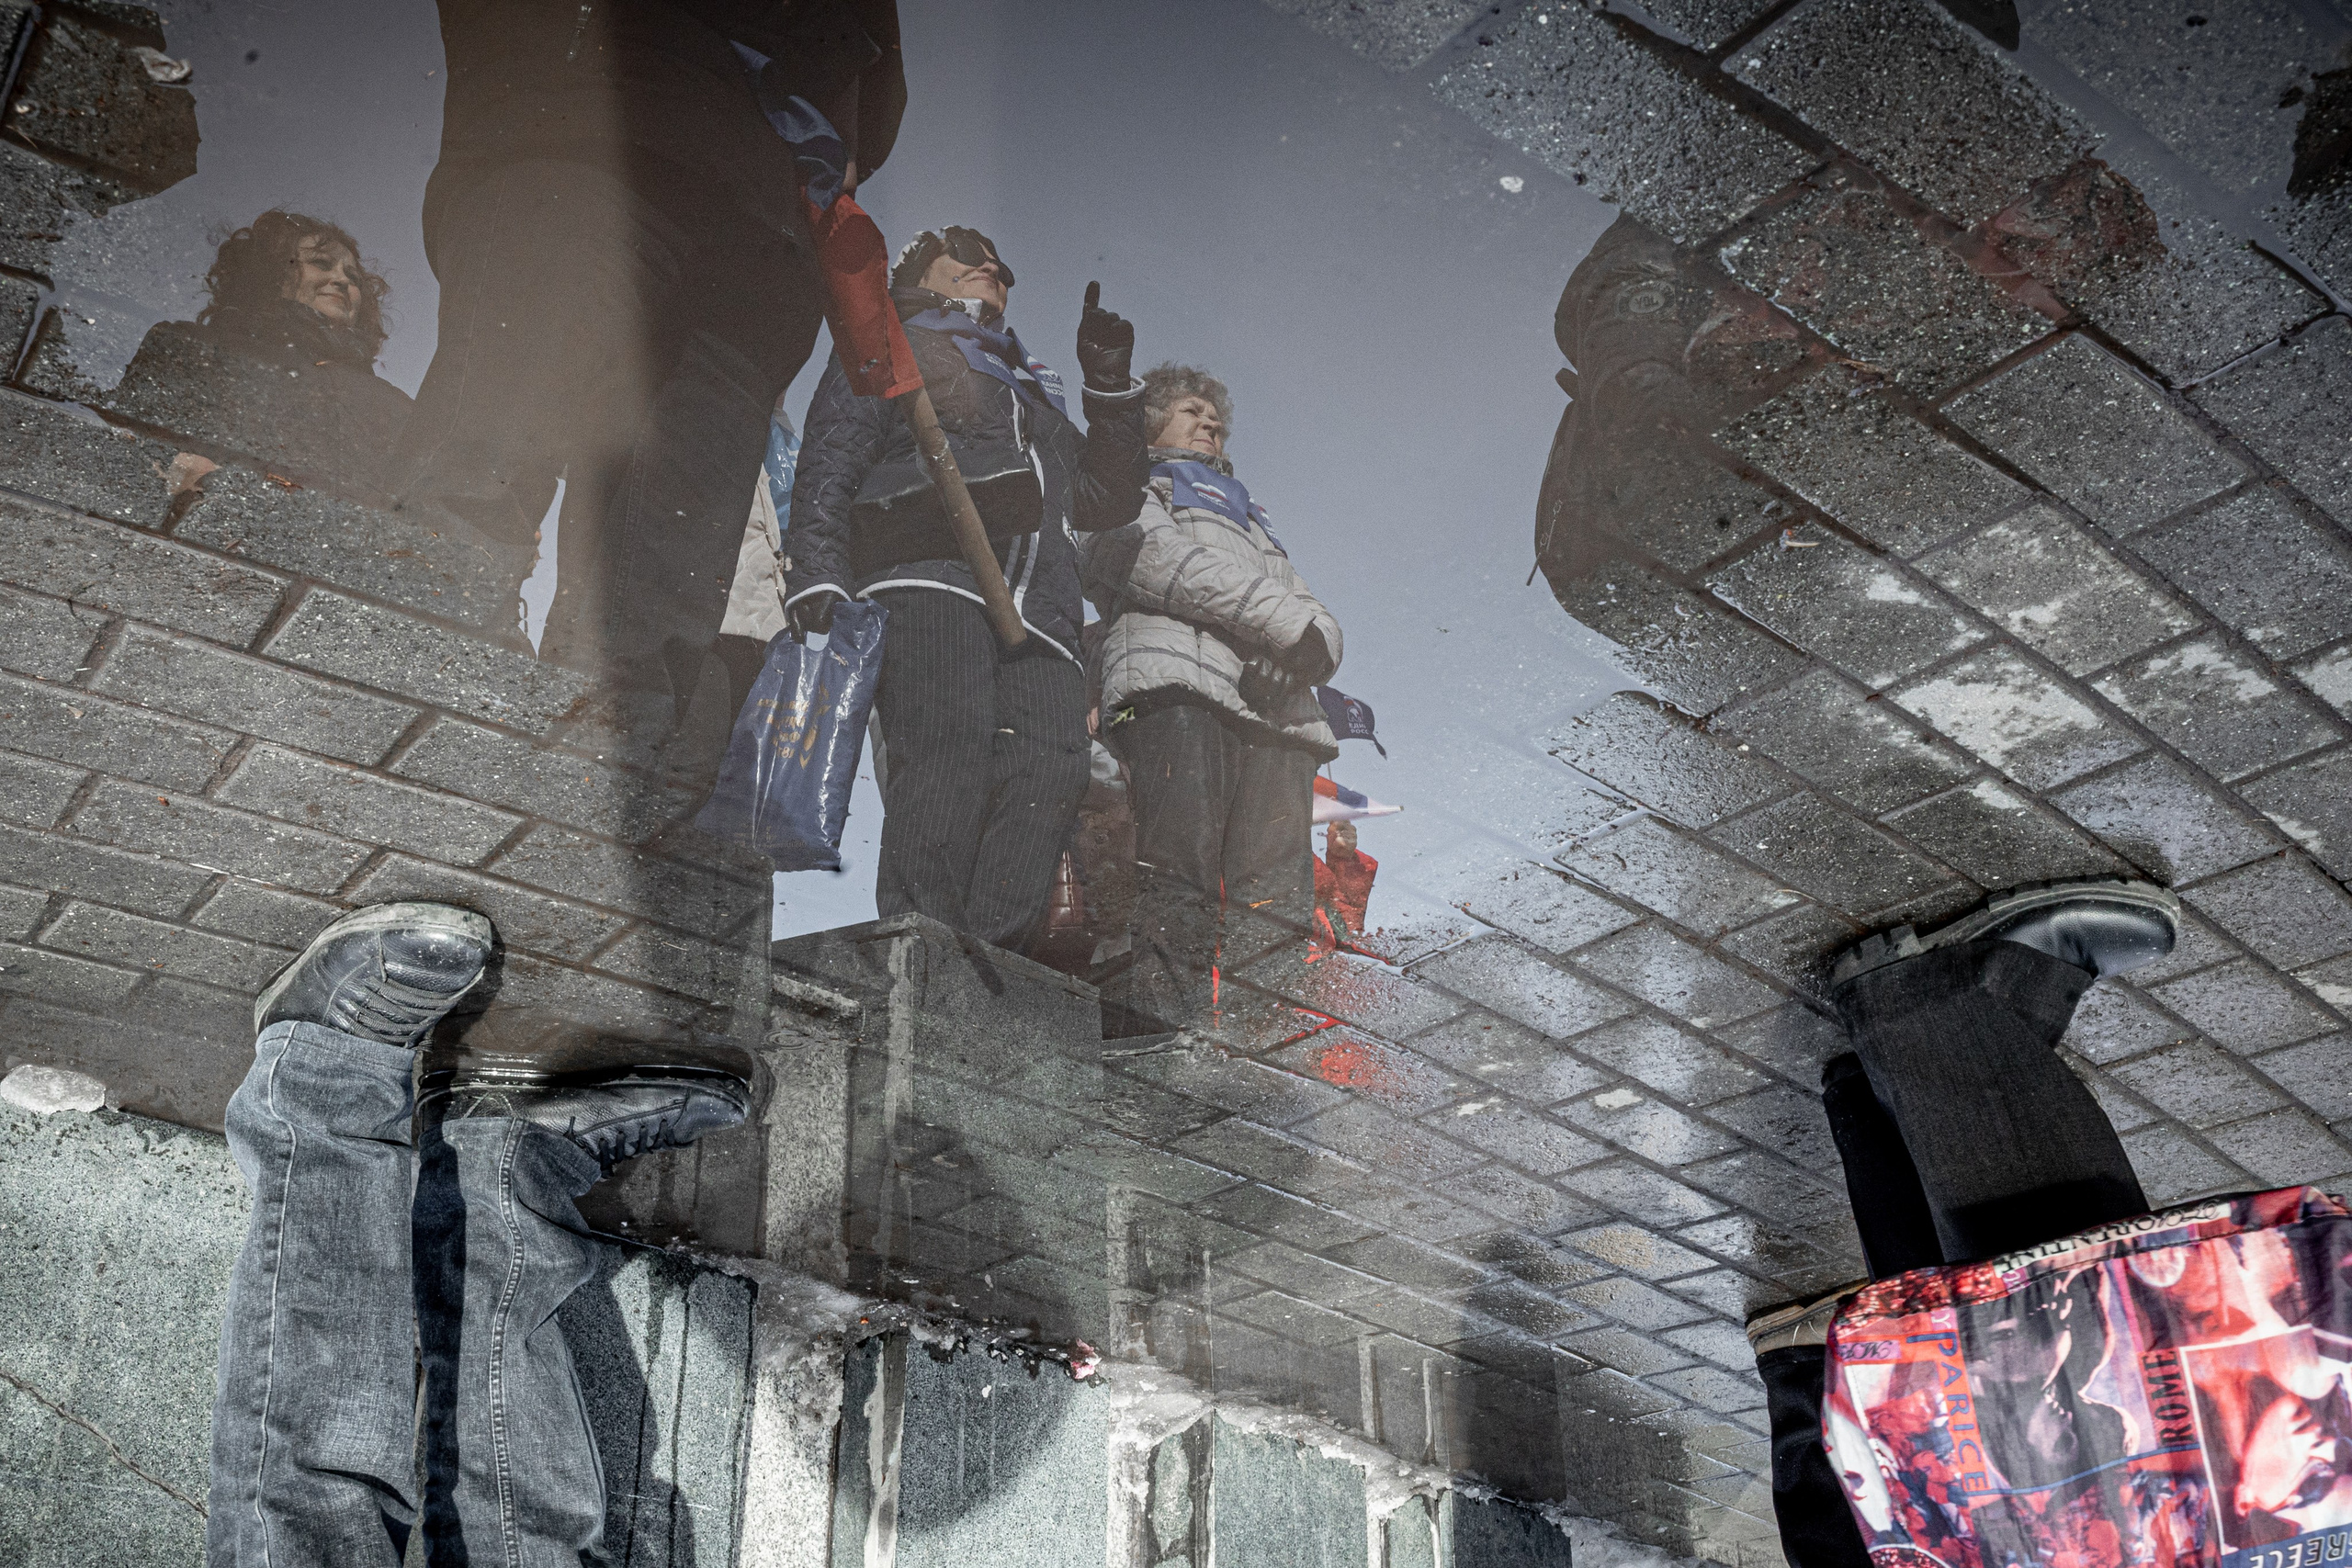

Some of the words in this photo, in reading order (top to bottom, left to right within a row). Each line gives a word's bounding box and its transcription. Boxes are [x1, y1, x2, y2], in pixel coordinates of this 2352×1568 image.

[1905, 1332, 1989, 1490] PARICE
[2143, 1350, 2195, 1445] ROME
[2249, 1531, 2352, 1568] REECE
